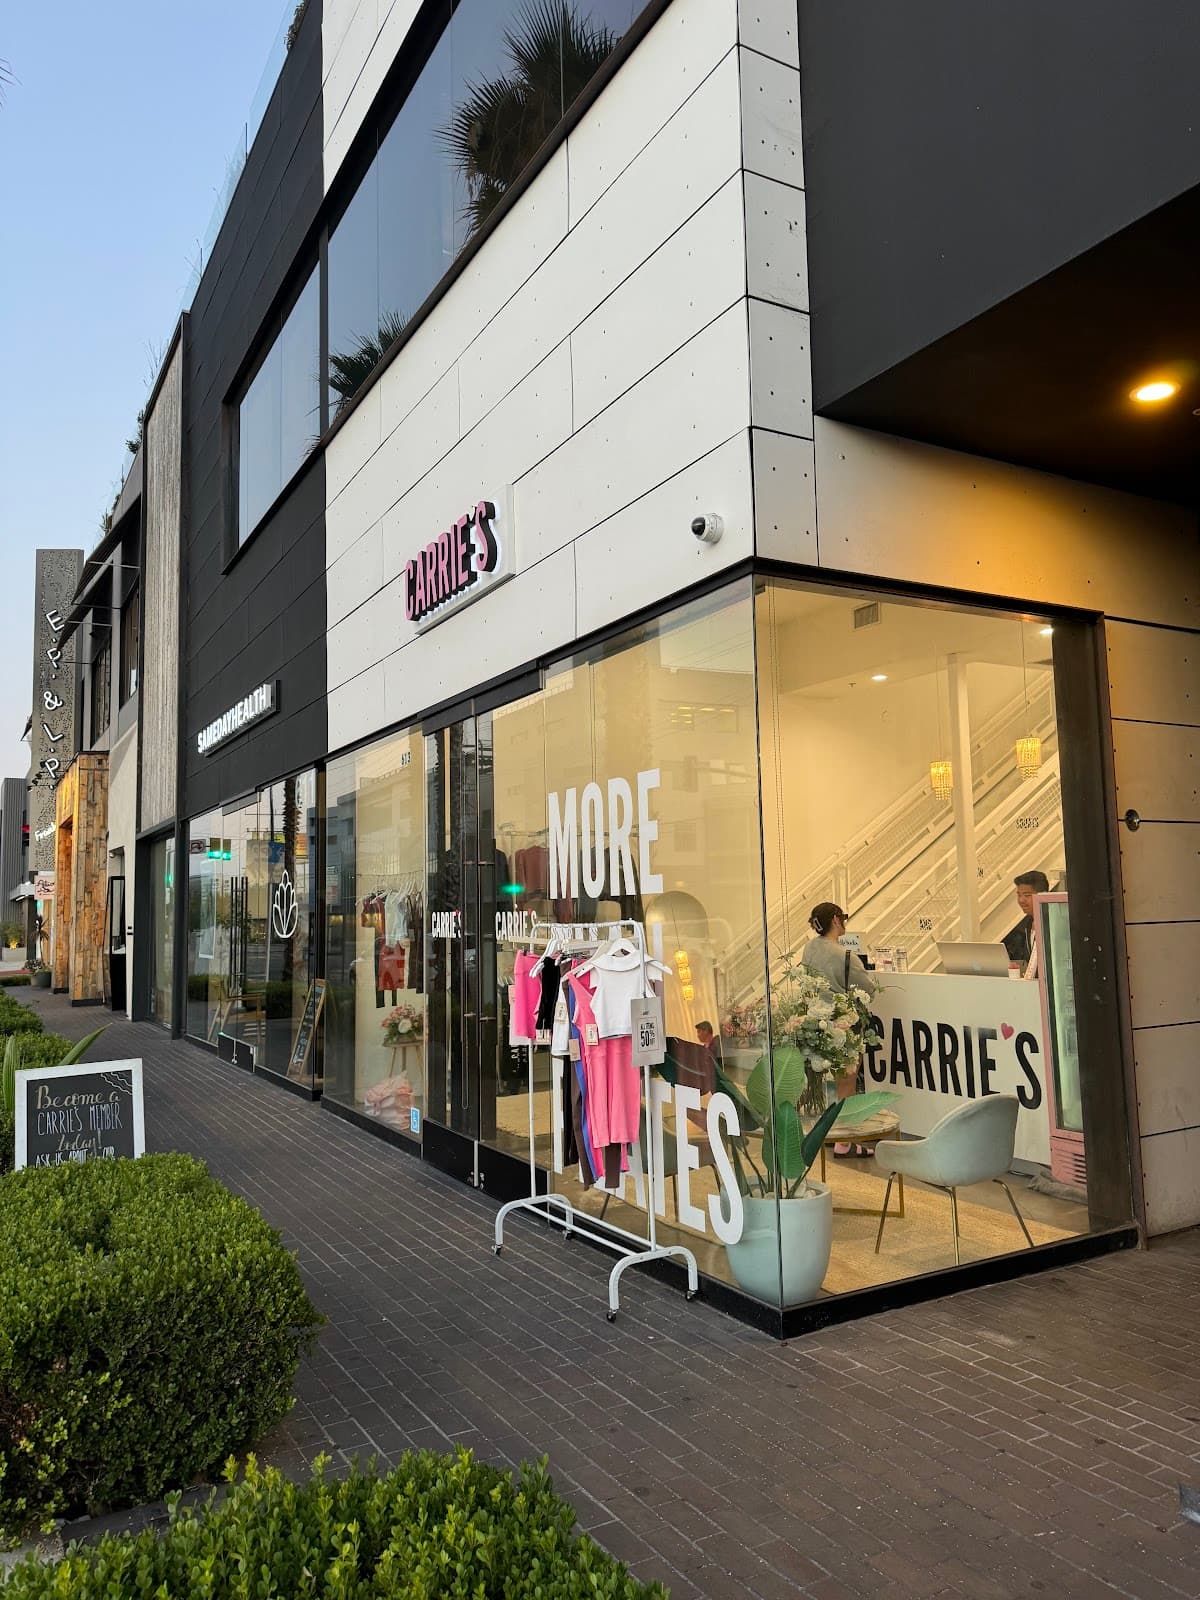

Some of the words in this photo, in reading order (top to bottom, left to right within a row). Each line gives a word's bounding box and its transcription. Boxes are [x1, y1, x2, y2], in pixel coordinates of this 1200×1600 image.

[404, 500, 495, 622] CARRIE'S
[548, 767, 663, 899] MORE
[35, 1084, 104, 1109] Become
[109, 1091, 120, 1103] a
[37, 1106, 83, 1136] CARRIE'S
[89, 1102, 122, 1131] MEMBER
